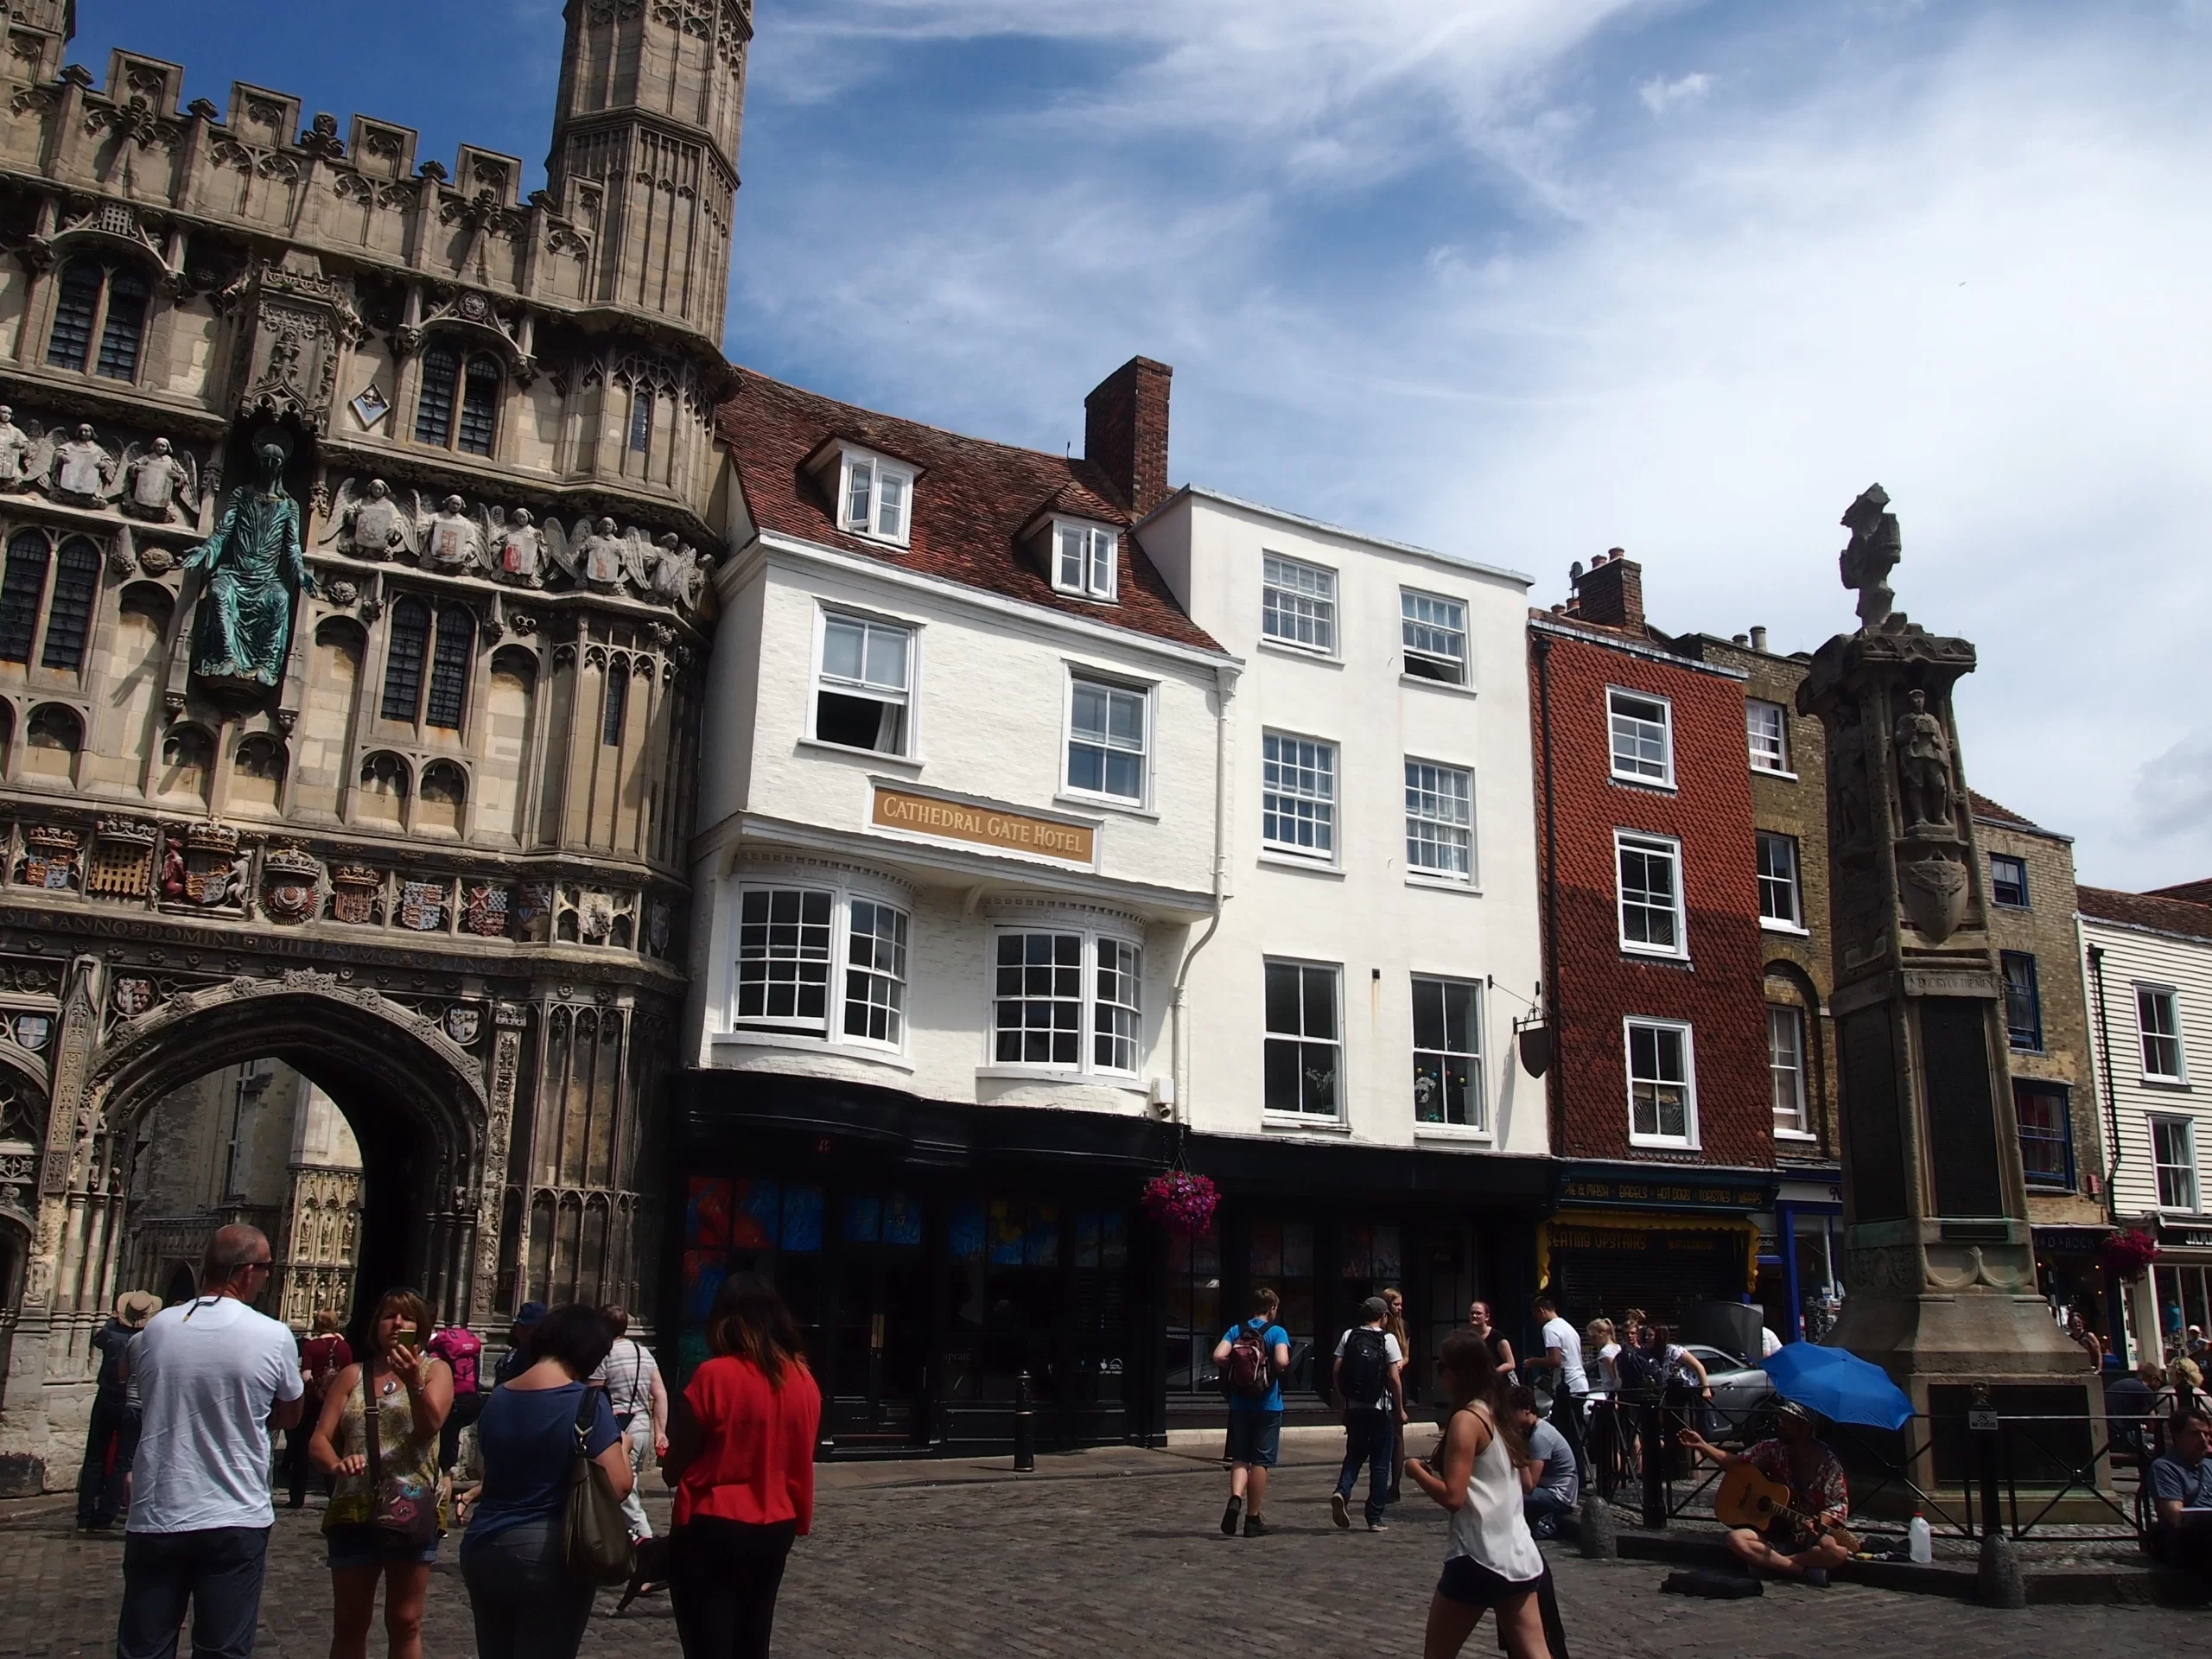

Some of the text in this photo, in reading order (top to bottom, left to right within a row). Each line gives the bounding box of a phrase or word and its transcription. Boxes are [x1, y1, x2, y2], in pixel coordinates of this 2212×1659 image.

[883, 797, 1084, 854] CATHEDRAL GATE HOTEL
[56, 914, 129, 936] ANNO
[1586, 1184, 1610, 1198] MASH
[1618, 1185, 1649, 1199] BAGELS
[1656, 1186, 1670, 1200] HOT
[1672, 1187, 1691, 1201] DOGS
[1698, 1188, 1731, 1203] TOASTIES
[1738, 1191, 1763, 1205] WRAPS
[1595, 1232, 1647, 1250] UPSTAIRS
[2065, 1236, 2095, 1249] ROCK
